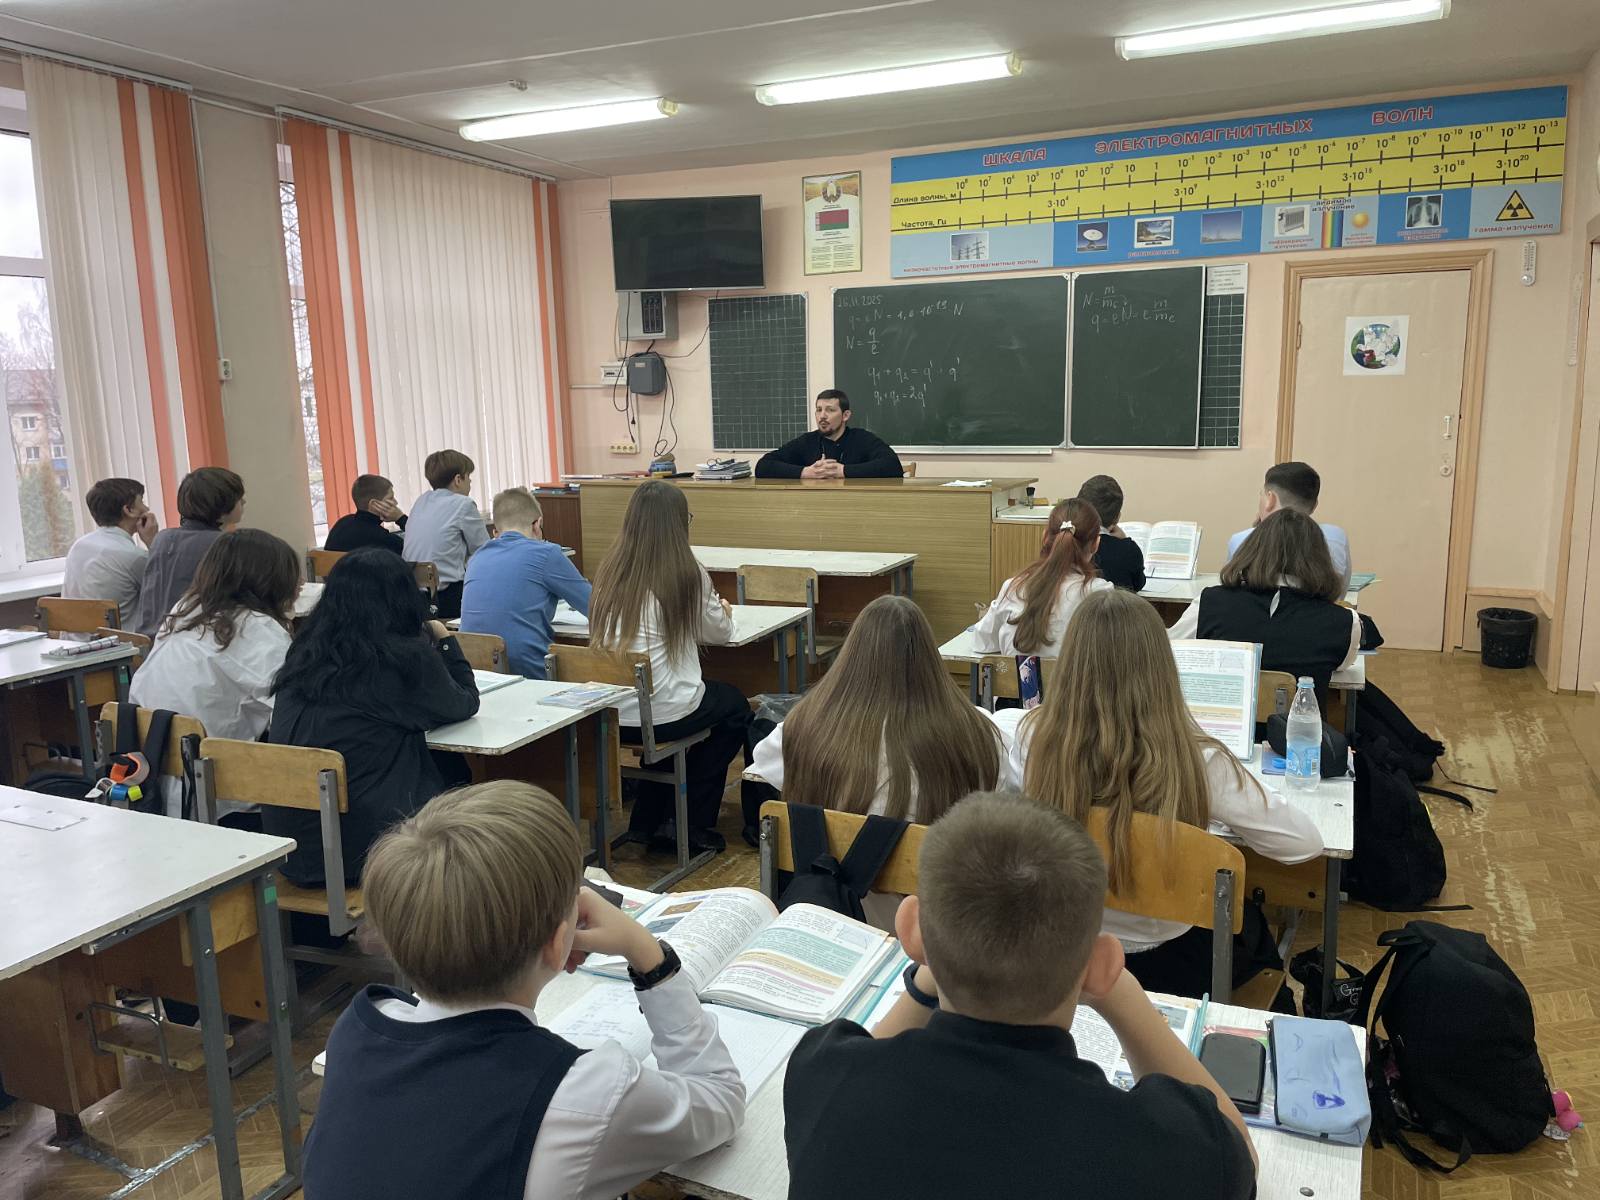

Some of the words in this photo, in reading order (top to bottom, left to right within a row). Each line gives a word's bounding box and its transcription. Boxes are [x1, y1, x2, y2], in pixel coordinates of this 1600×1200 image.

[983, 147, 1047, 166] ШКАЛА
[1094, 118, 1313, 154] ЭЛЕКТРОМАГНИТНЫХ
[1372, 106, 1434, 126] ВОЛН
[893, 196, 918, 204] Длина
[1125, 164, 1136, 173] 10
[1154, 162, 1159, 170] 1
[901, 220, 935, 228] Частота,
[1474, 223, 1554, 233] гамма-излучение
